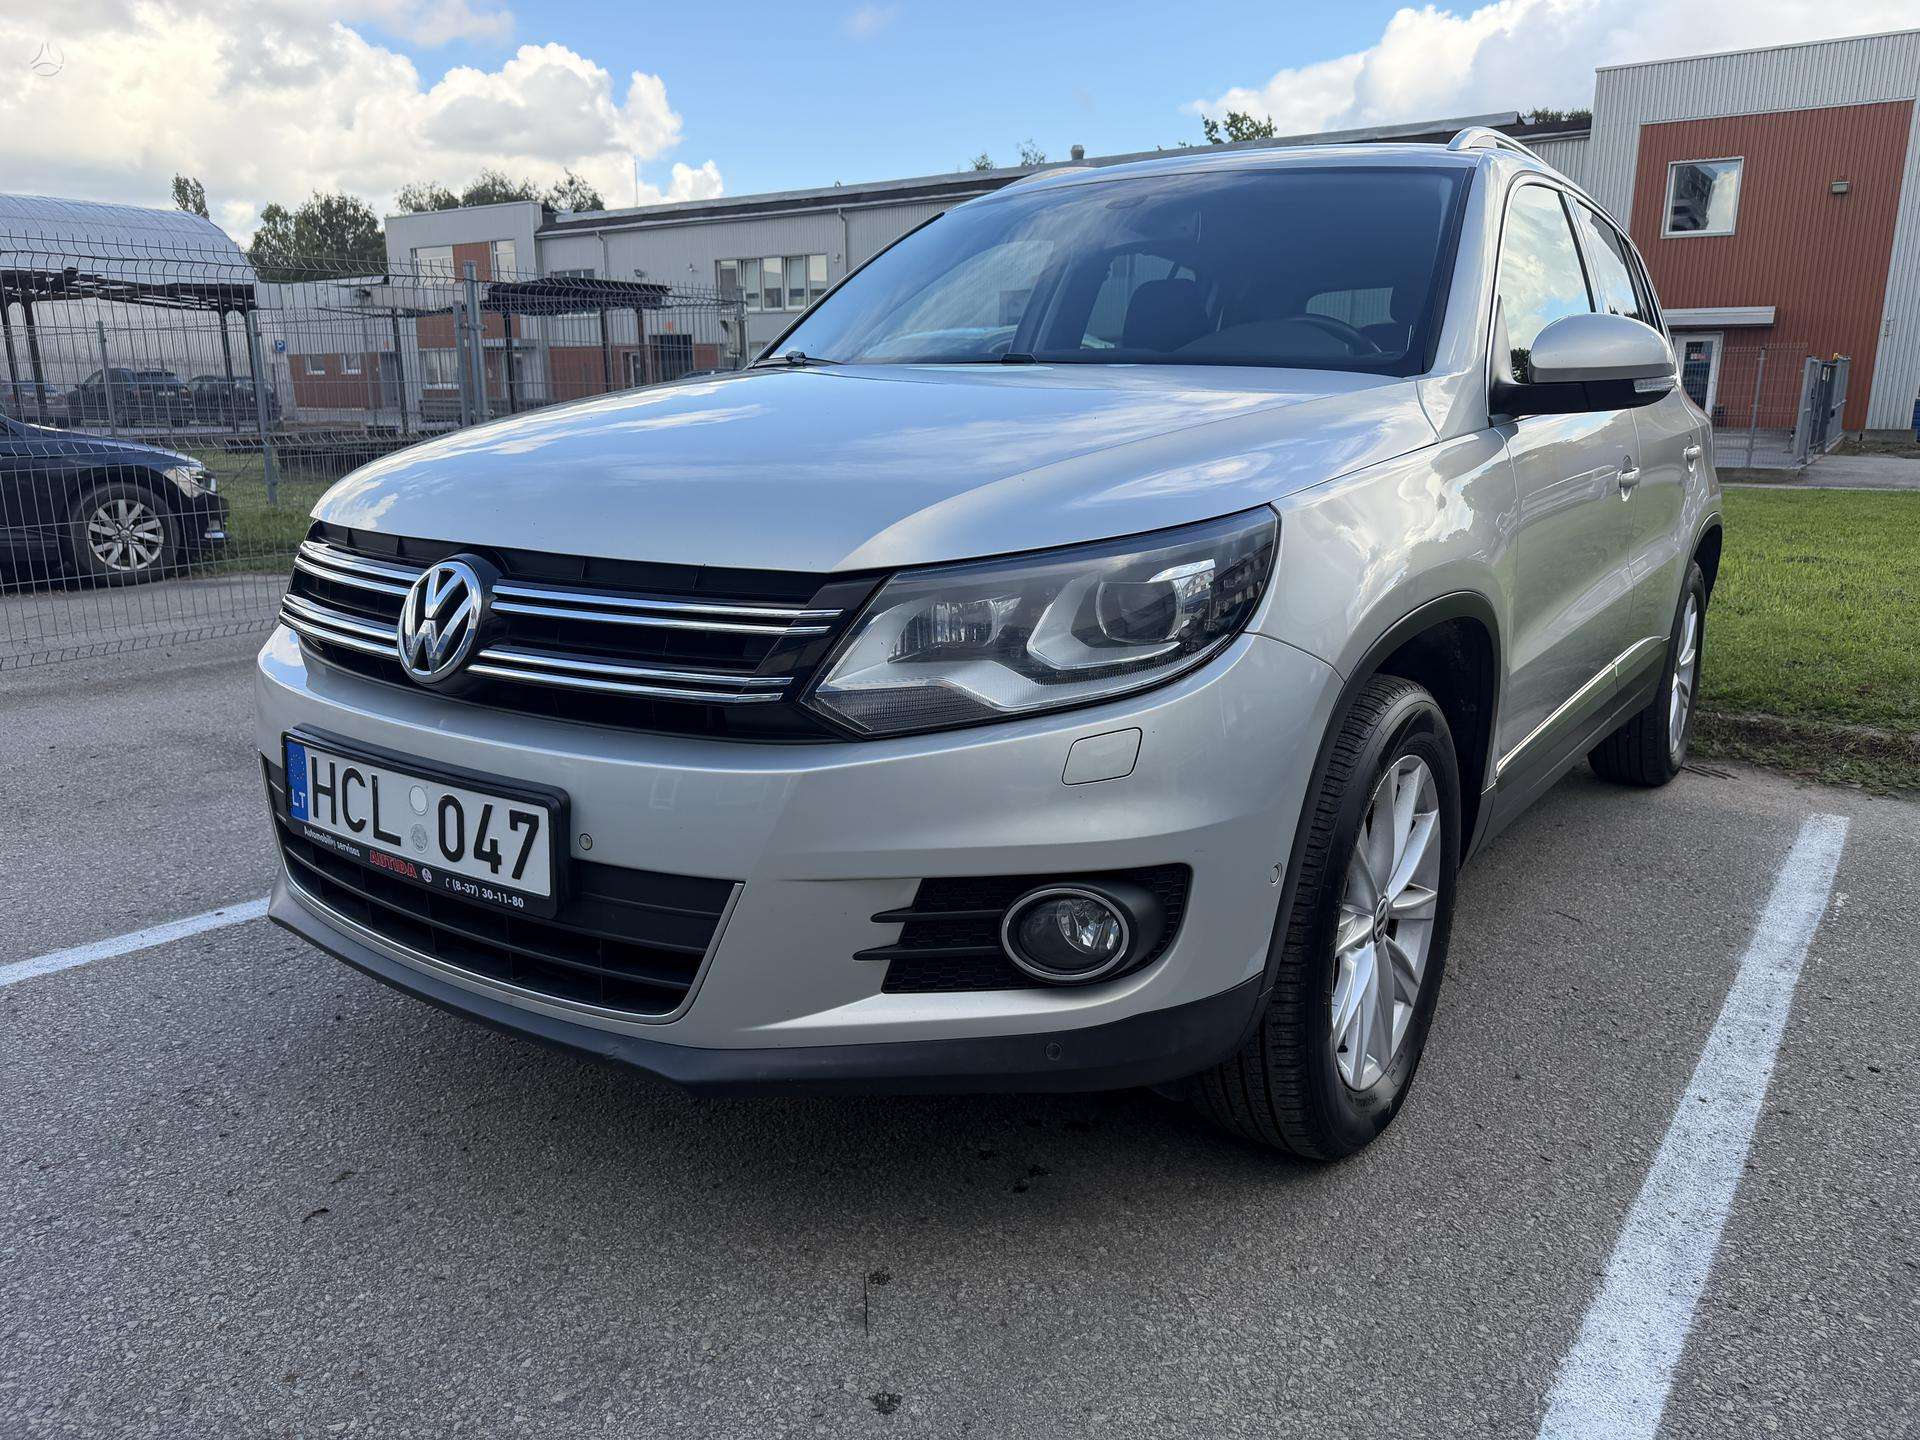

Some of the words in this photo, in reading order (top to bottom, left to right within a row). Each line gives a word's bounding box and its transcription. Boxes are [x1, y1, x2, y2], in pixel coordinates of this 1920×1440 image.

[292, 791, 305, 809] LT
[311, 756, 401, 847] HCL
[437, 794, 541, 880] 047
[452, 879, 479, 897] (8-37)
[481, 888, 524, 908] 30-11-80
